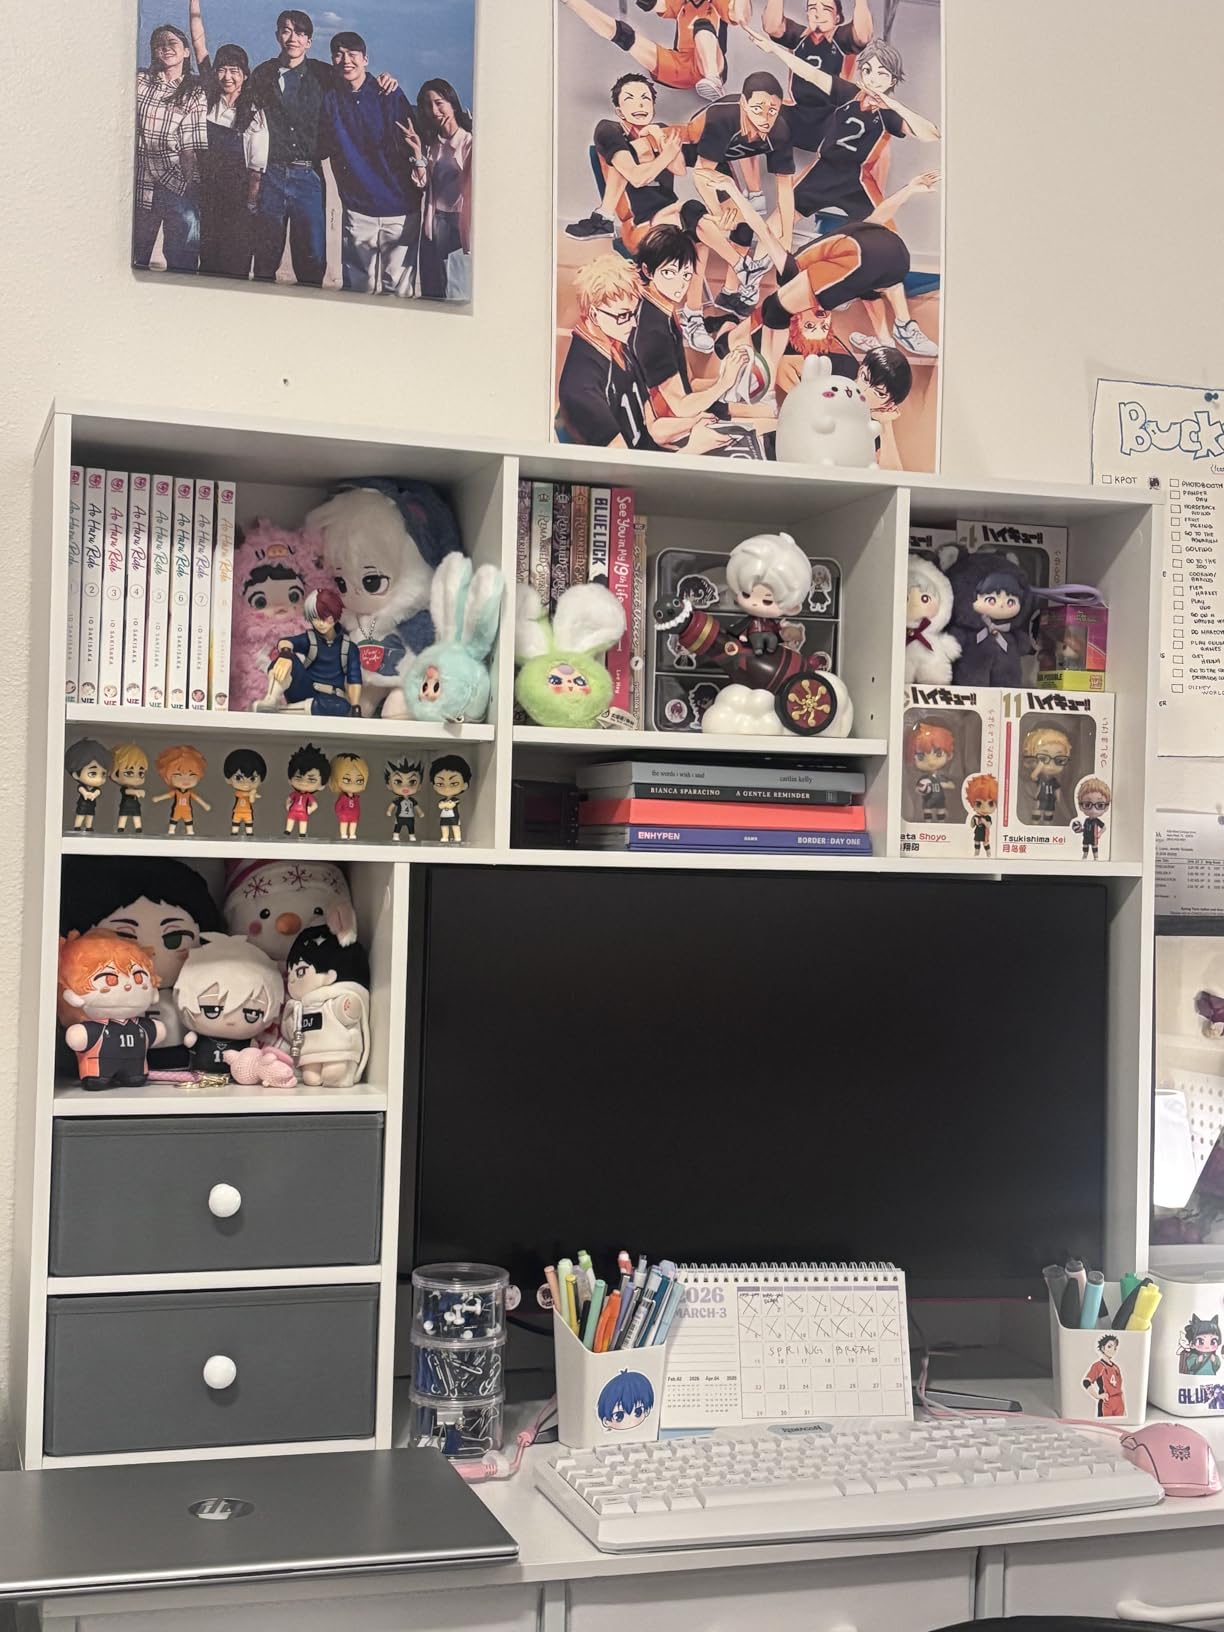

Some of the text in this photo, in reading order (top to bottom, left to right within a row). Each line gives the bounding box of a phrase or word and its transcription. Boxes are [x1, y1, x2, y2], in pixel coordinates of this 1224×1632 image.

[836, 117, 866, 152] 2
[1114, 476, 1138, 484] KPOT
[1182, 481, 1224, 489] PHOTOBOOTH
[88, 503, 102, 518] Ao
[110, 507, 124, 520] Ao
[133, 505, 147, 519] Ao
[154, 510, 169, 523] Ao
[176, 512, 191, 527] Ao
[197, 514, 211, 528] Ao
[220, 518, 233, 532] Ao
[88, 519, 101, 543] Haru
[110, 523, 123, 547] Haru
[132, 522, 146, 546] Haru
[155, 527, 168, 550] Haru
[537, 513, 550, 563] REMARRIED
[176, 529, 190, 553] Haru
[197, 530, 209, 553] Haru
[220, 535, 233, 557] Haru
[556, 515, 569, 566] REMARRIED
[86, 544, 101, 569] Ride
[613, 495, 632, 603] See You in My 19th Life
[109, 548, 123, 573] Ride
[131, 547, 146, 571] Ride
[153, 551, 169, 576] Ride
[175, 553, 190, 578] Ride
[196, 555, 210, 578] Ride
[219, 560, 232, 583] Ride
[89, 585, 95, 594] 2
[111, 588, 117, 597] 3
[134, 588, 139, 596] 4
[632, 607, 642, 647] Voice
[1002, 692, 1022, 718] 11
[798, 775, 813, 784] kelly
[680, 788, 720, 796] SPARACINO
[742, 790, 771, 798] GENTLE
[773, 791, 811, 799] REMINDER
[638, 831, 681, 841] ENHYPEN
[830, 837, 844, 845] DAY
[845, 838, 861, 846] ONE
[919, 833, 947, 842] Shoyo
[1003, 834, 1050, 843] Tsukishima
[119, 1034, 134, 1048] 10
[673, 1307, 728, 1319] MARCH-3
[769, 1345, 876, 1357] SPRING BREAK
[1110, 1374, 1118, 1387] 4
